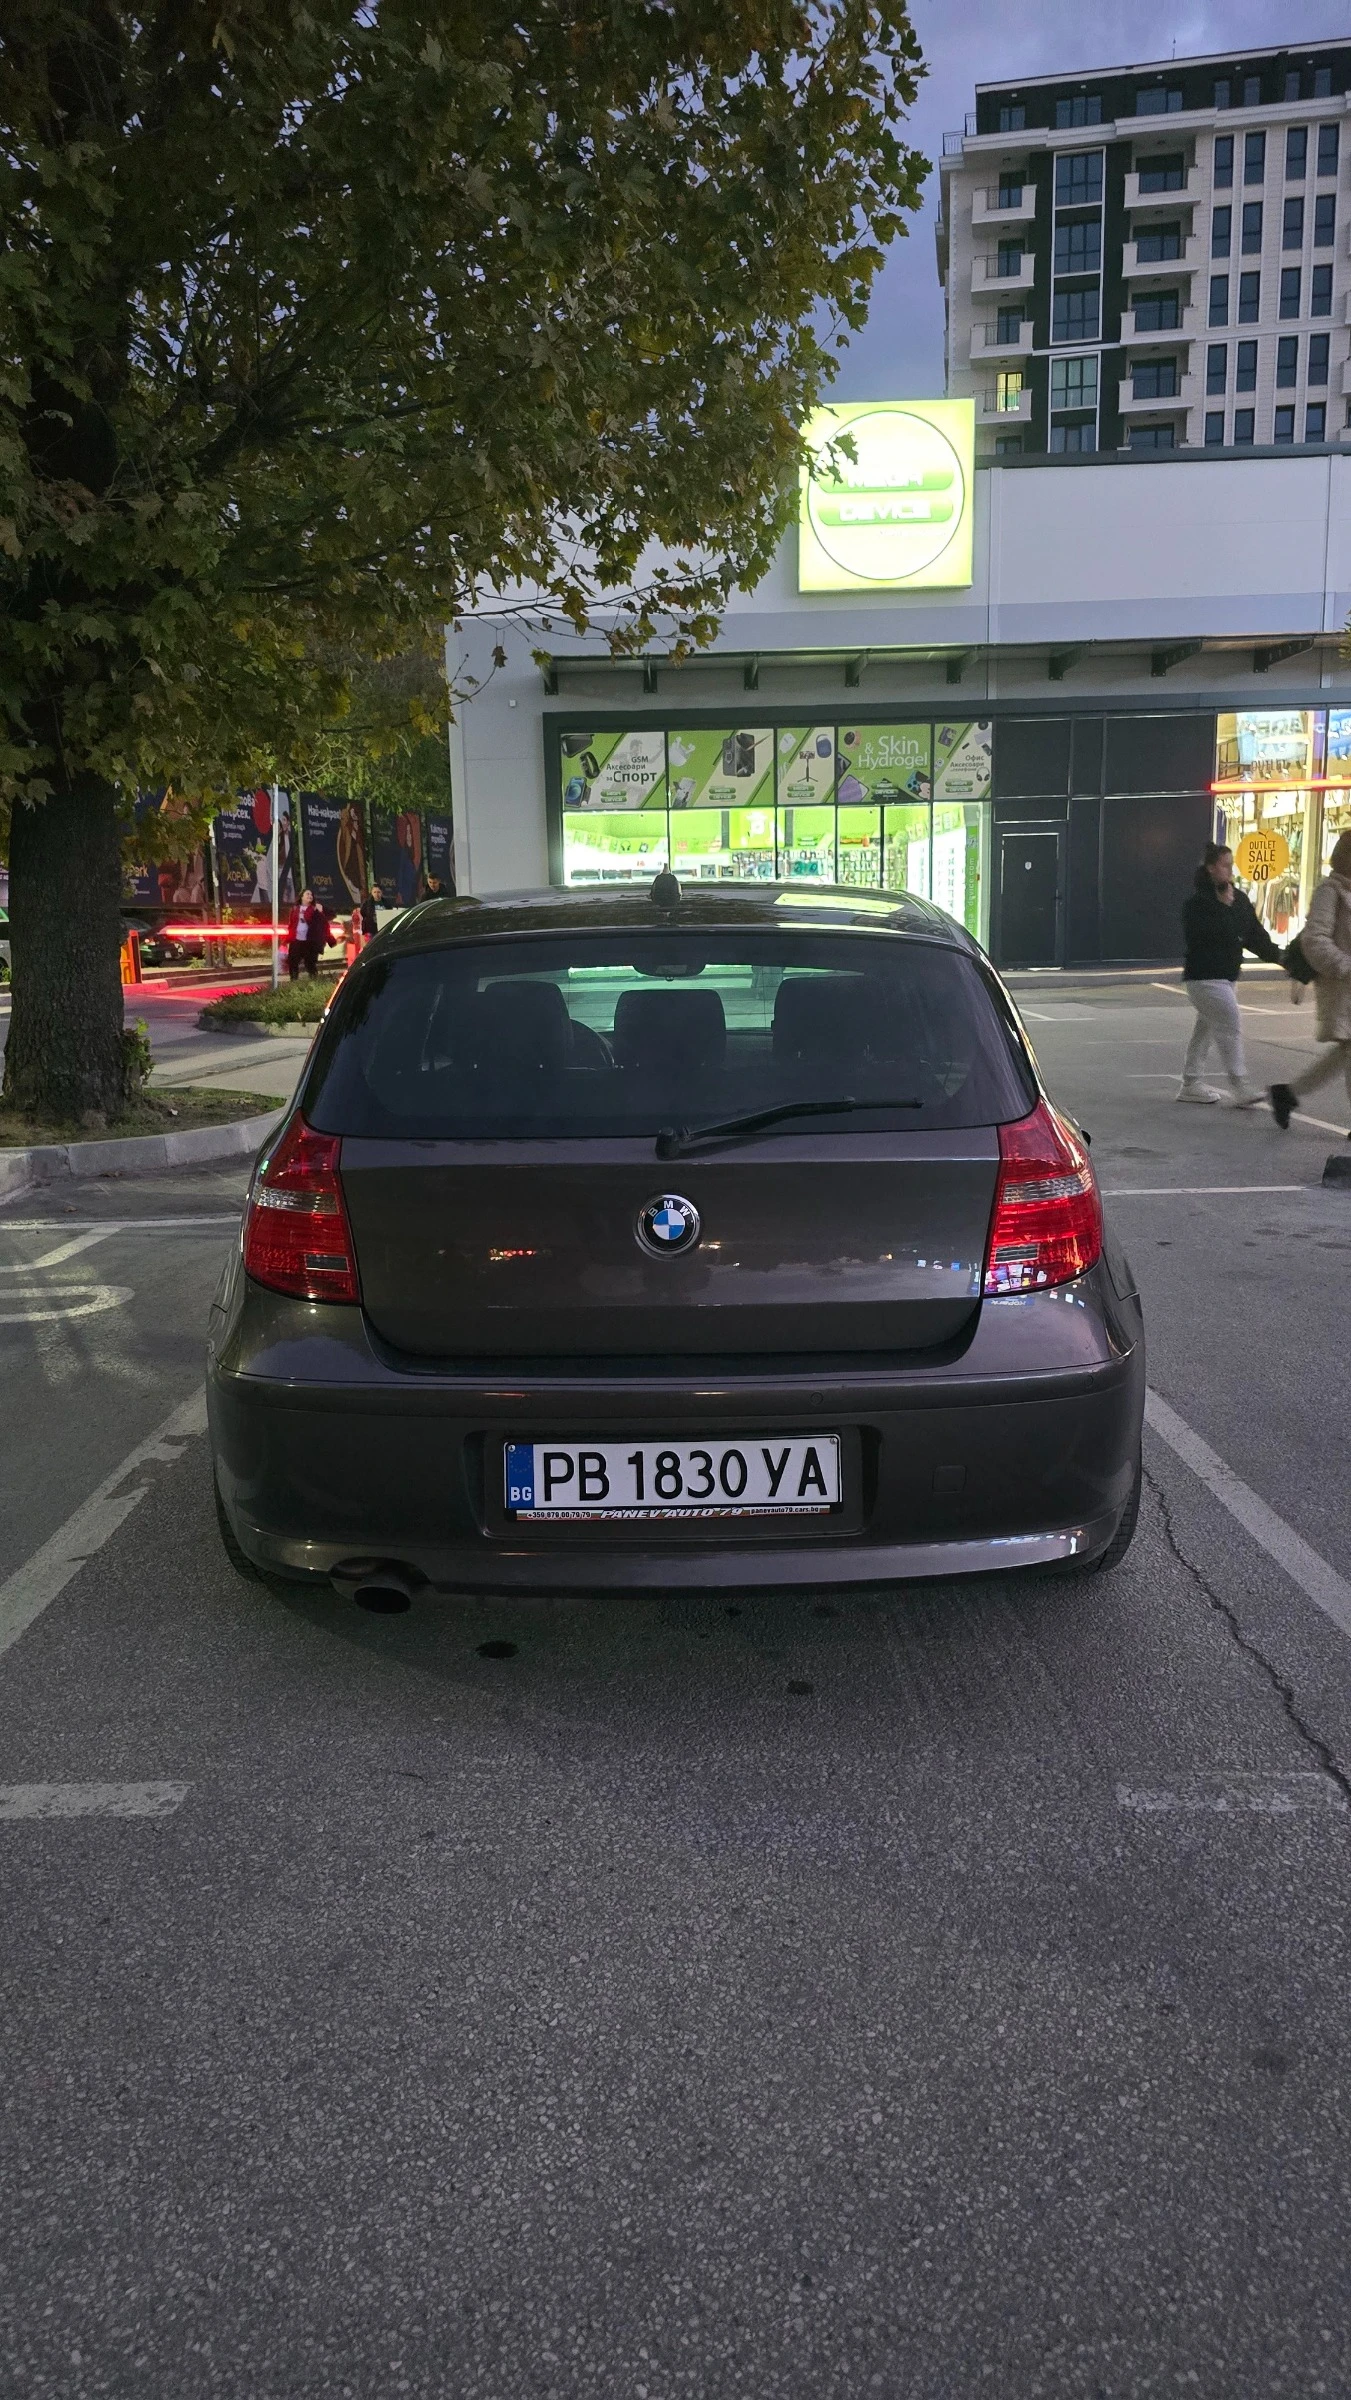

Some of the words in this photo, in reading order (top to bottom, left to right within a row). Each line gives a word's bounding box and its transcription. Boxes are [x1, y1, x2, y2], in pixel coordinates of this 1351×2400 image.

[865, 742, 874, 754] &
[878, 735, 919, 755] Skin
[631, 755, 649, 763] GSM
[858, 752, 928, 770] Hydrogel
[965, 754, 985, 762] Офис
[606, 763, 646, 771] Аксесоари
[949, 761, 985, 769] Аксесоари
[613, 770, 657, 785] Спорт
[1249, 840, 1276, 850] OUTLET
[1248, 849, 1276, 862] SALE
[647, 1200, 691, 1217] BMW
[543, 1451, 610, 1501] PB
[627, 1448, 748, 1500] 1830
[761, 1446, 828, 1497] YA
[510, 1486, 532, 1501] BG
[600, 1509, 661, 1519] PANEV
[664, 1508, 716, 1518] AUTO
[718, 1507, 744, 1516] 79
